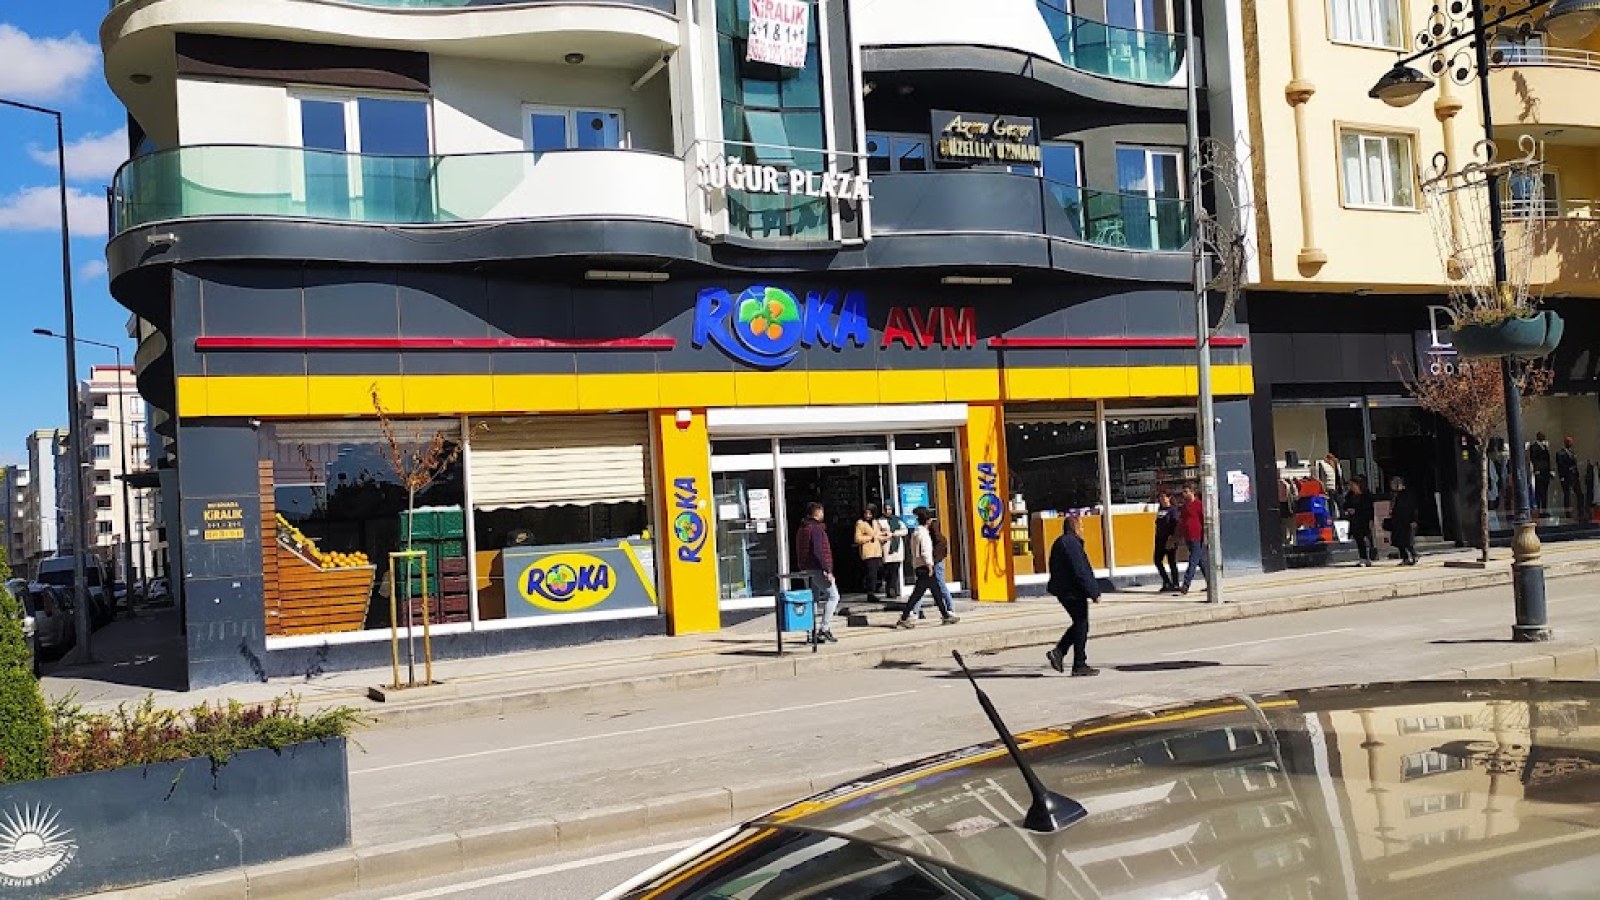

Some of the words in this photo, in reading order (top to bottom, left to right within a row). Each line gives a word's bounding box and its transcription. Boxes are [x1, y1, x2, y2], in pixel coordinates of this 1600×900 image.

[788, 169, 869, 199] PLAZA
[692, 286, 869, 369] ROKA
[880, 306, 977, 350] AVM
[674, 477, 708, 563] ROKA
[977, 462, 1005, 540] ROKA
[527, 563, 609, 603] ROKA
